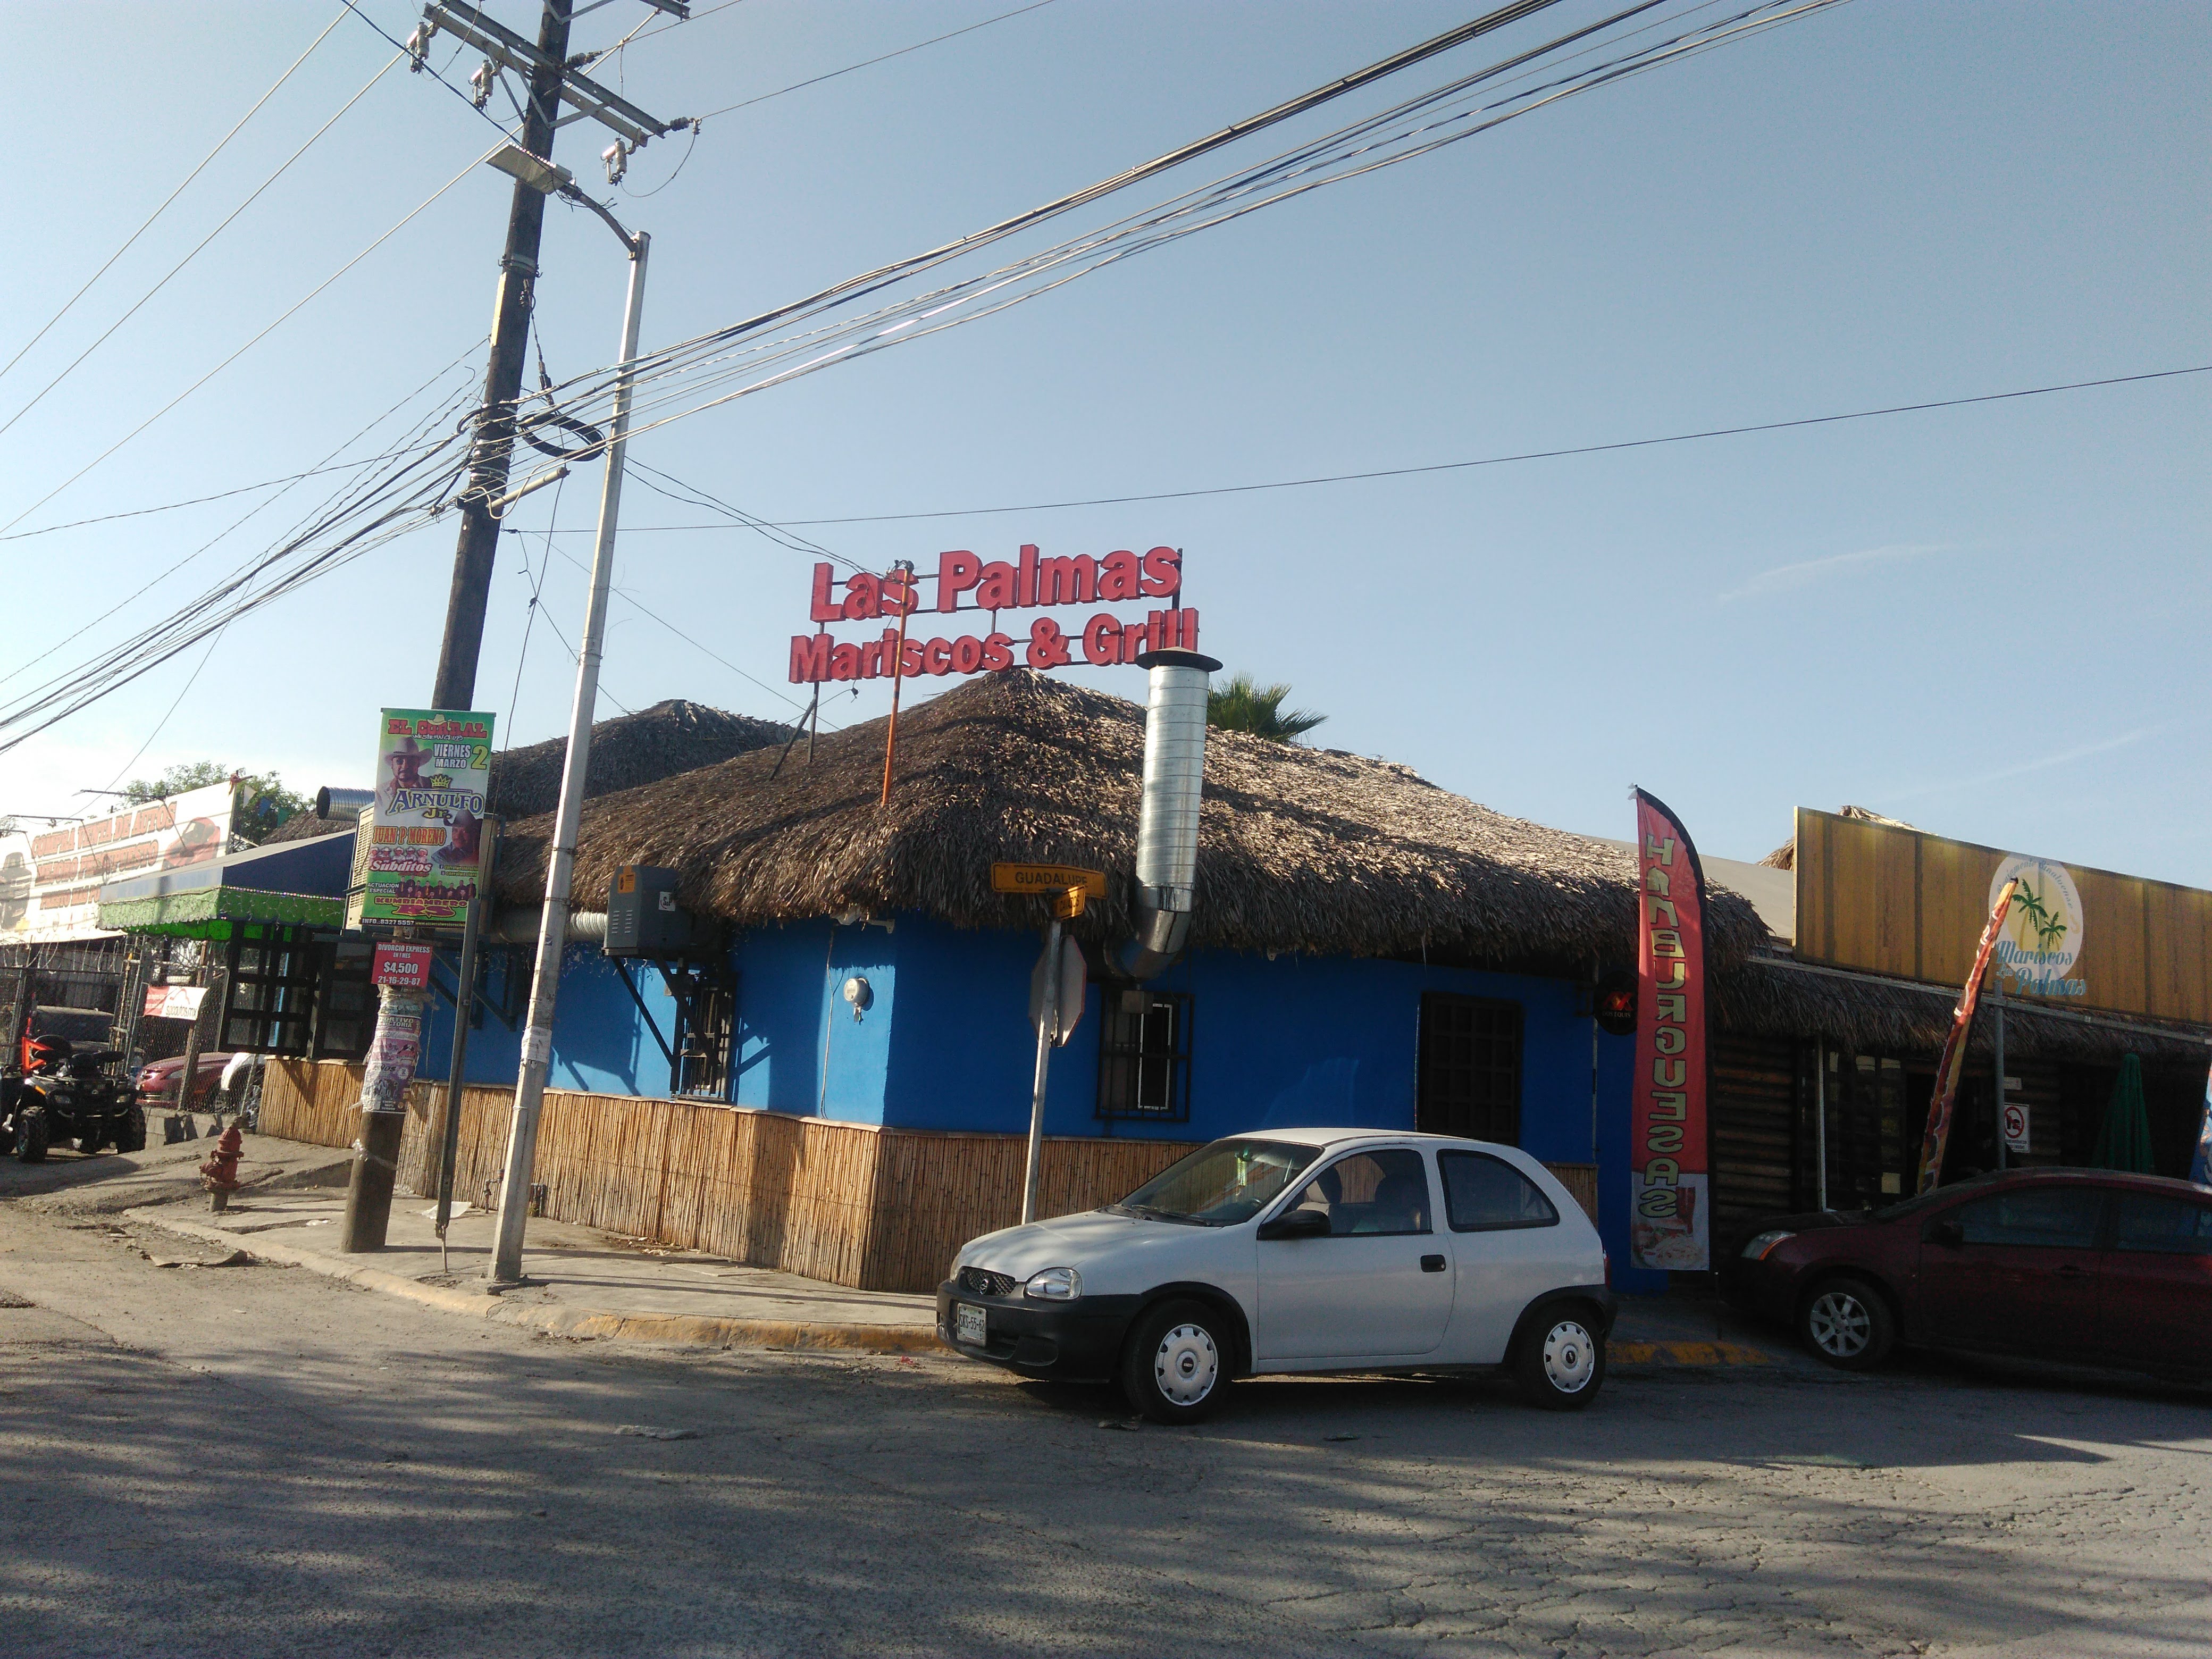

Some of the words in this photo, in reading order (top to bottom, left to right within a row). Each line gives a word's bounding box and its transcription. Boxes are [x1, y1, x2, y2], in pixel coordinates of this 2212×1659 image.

[810, 562, 919, 623] Las
[936, 543, 1183, 614] Palmas
[788, 628, 1016, 684] Mariscos
[1026, 616, 1072, 670] &
[1083, 607, 1200, 666] Grill
[388, 719, 412, 735] EL
[417, 720, 488, 739] CORRAL
[433, 743, 471, 758] VIERNES
[471, 745, 489, 769] 2
[435, 758, 467, 769] MARZO
[389, 790, 483, 815] ARNULFO
[423, 808, 452, 818] Jr.
[31, 828, 76, 859] COMPRA
[114, 812, 132, 839] DE
[132, 801, 177, 837] AUTOS
[373, 827, 398, 844] JUAN
[399, 827, 407, 844] P
[408, 827, 446, 845] MORENO
[1015, 871, 1088, 887] GUADALUPE
[1996, 940, 2073, 965] Mariscos
[383, 961, 419, 974] $4,500
[378, 976, 421, 985] 21-16-29-87
[2014, 967, 2087, 996] Palmas
